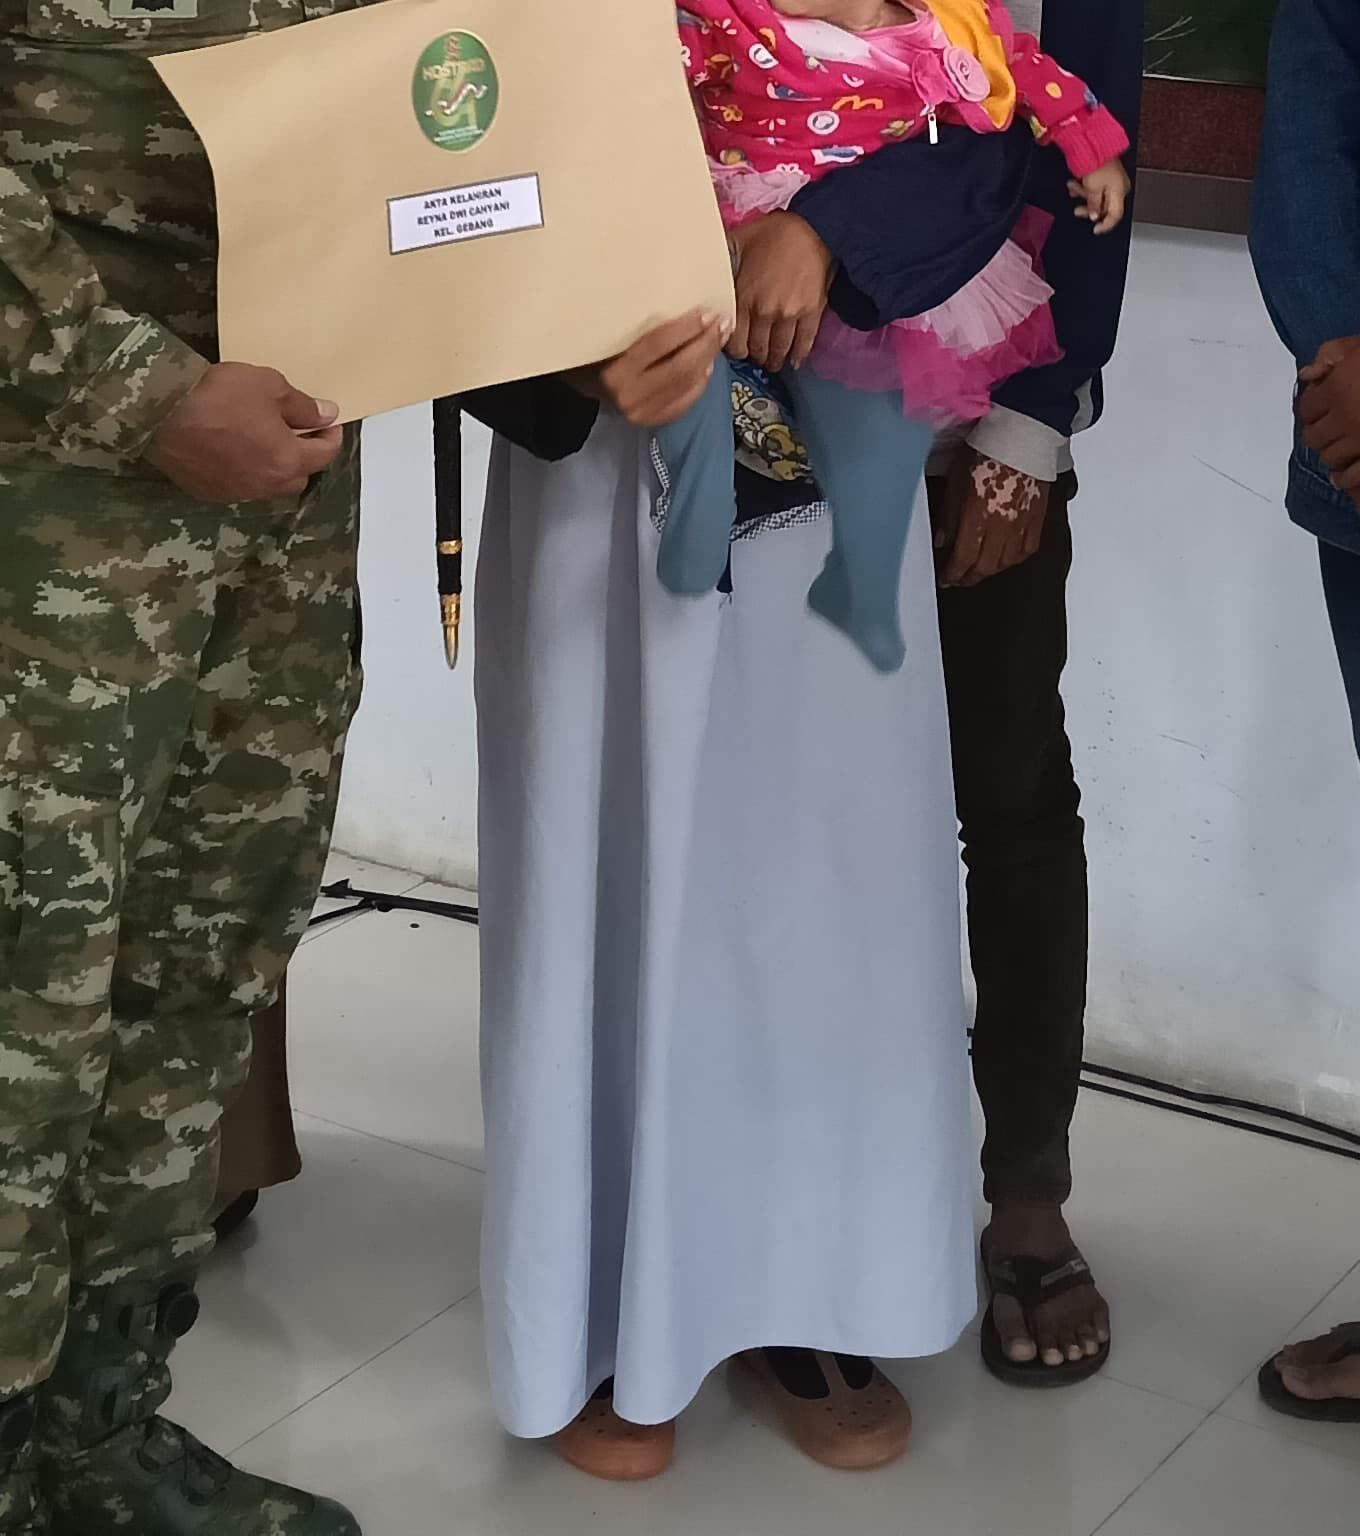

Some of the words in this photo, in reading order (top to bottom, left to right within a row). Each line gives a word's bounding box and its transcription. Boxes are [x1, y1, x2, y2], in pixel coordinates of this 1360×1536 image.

[423, 196, 448, 210] AKTA
[450, 186, 502, 205] KELAHIRAN
[449, 209, 467, 220] DWI
